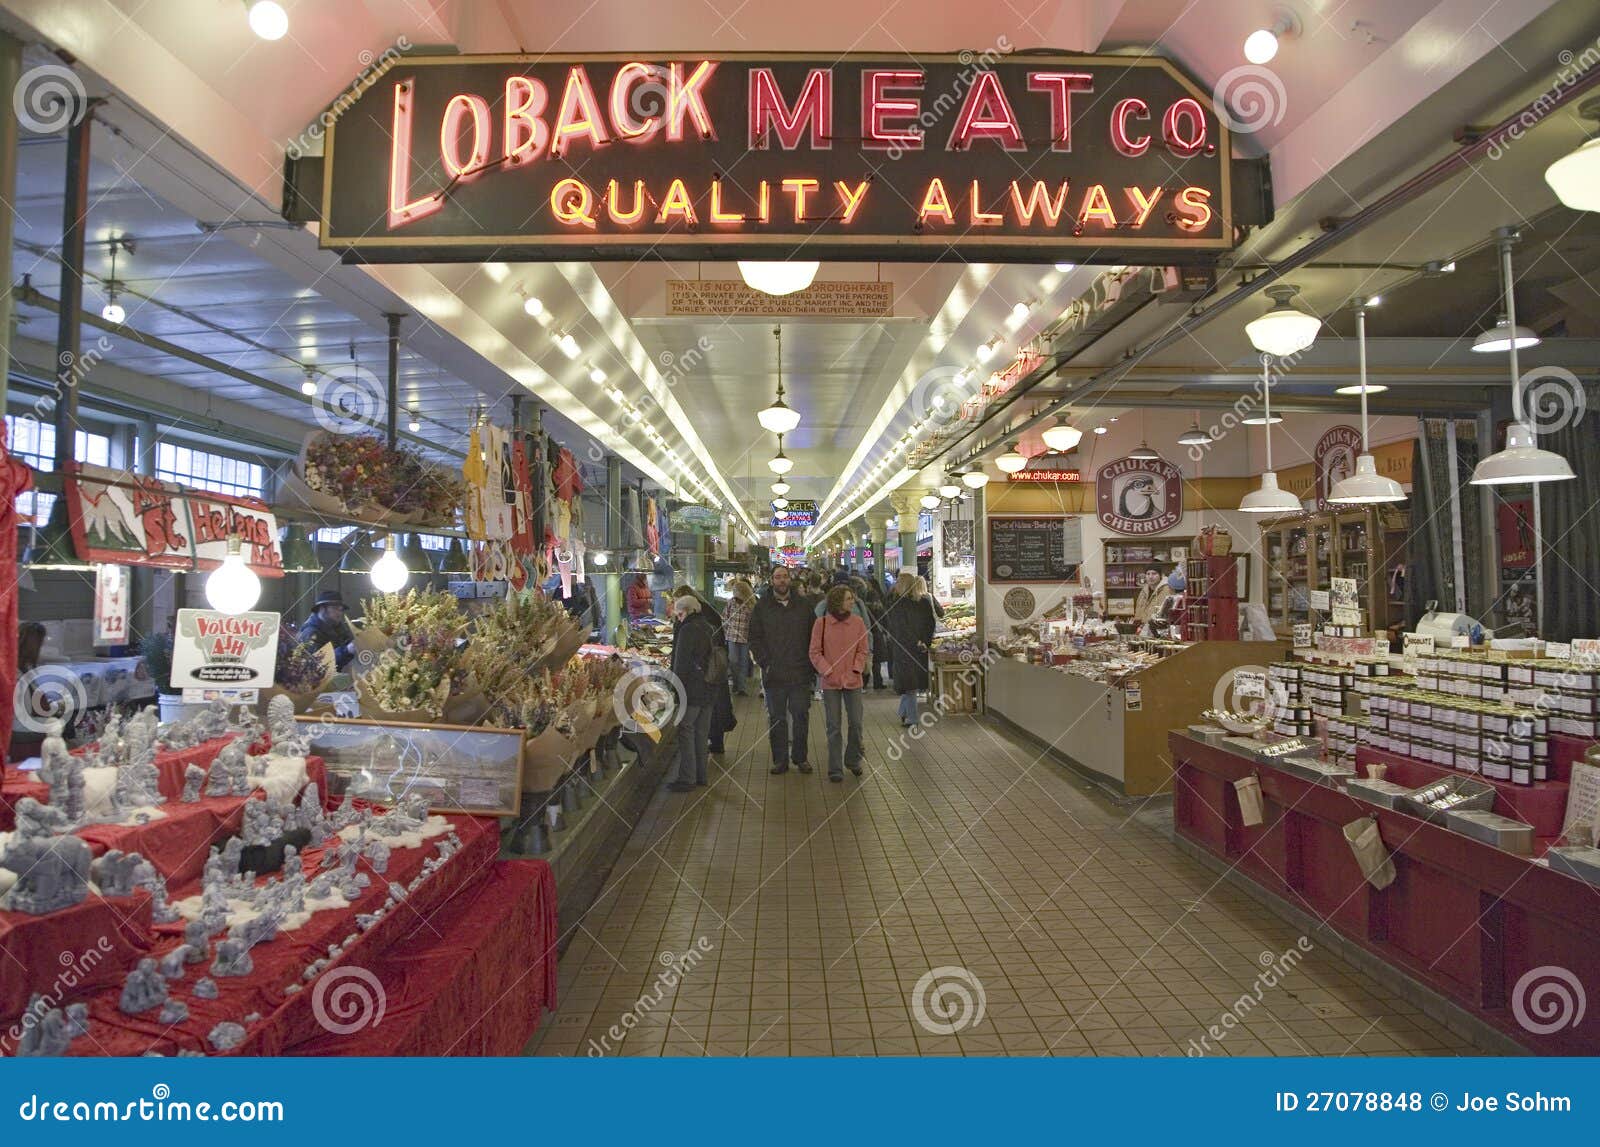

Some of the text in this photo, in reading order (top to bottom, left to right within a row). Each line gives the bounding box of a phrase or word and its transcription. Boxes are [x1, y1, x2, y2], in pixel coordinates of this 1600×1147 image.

[386, 61, 721, 229] LOBACK
[748, 67, 1094, 152] MEAT
[550, 177, 1212, 233] QUALITY ALWAYS
[671, 283, 695, 292] THIS
[700, 283, 712, 292] IS
[715, 283, 737, 292] NOT
[853, 293, 888, 301] PATRONS
[1011, 470, 1080, 481] www.chukar.com
[1103, 511, 1177, 532] CHERRIES
[212, 636, 245, 656] ASH
